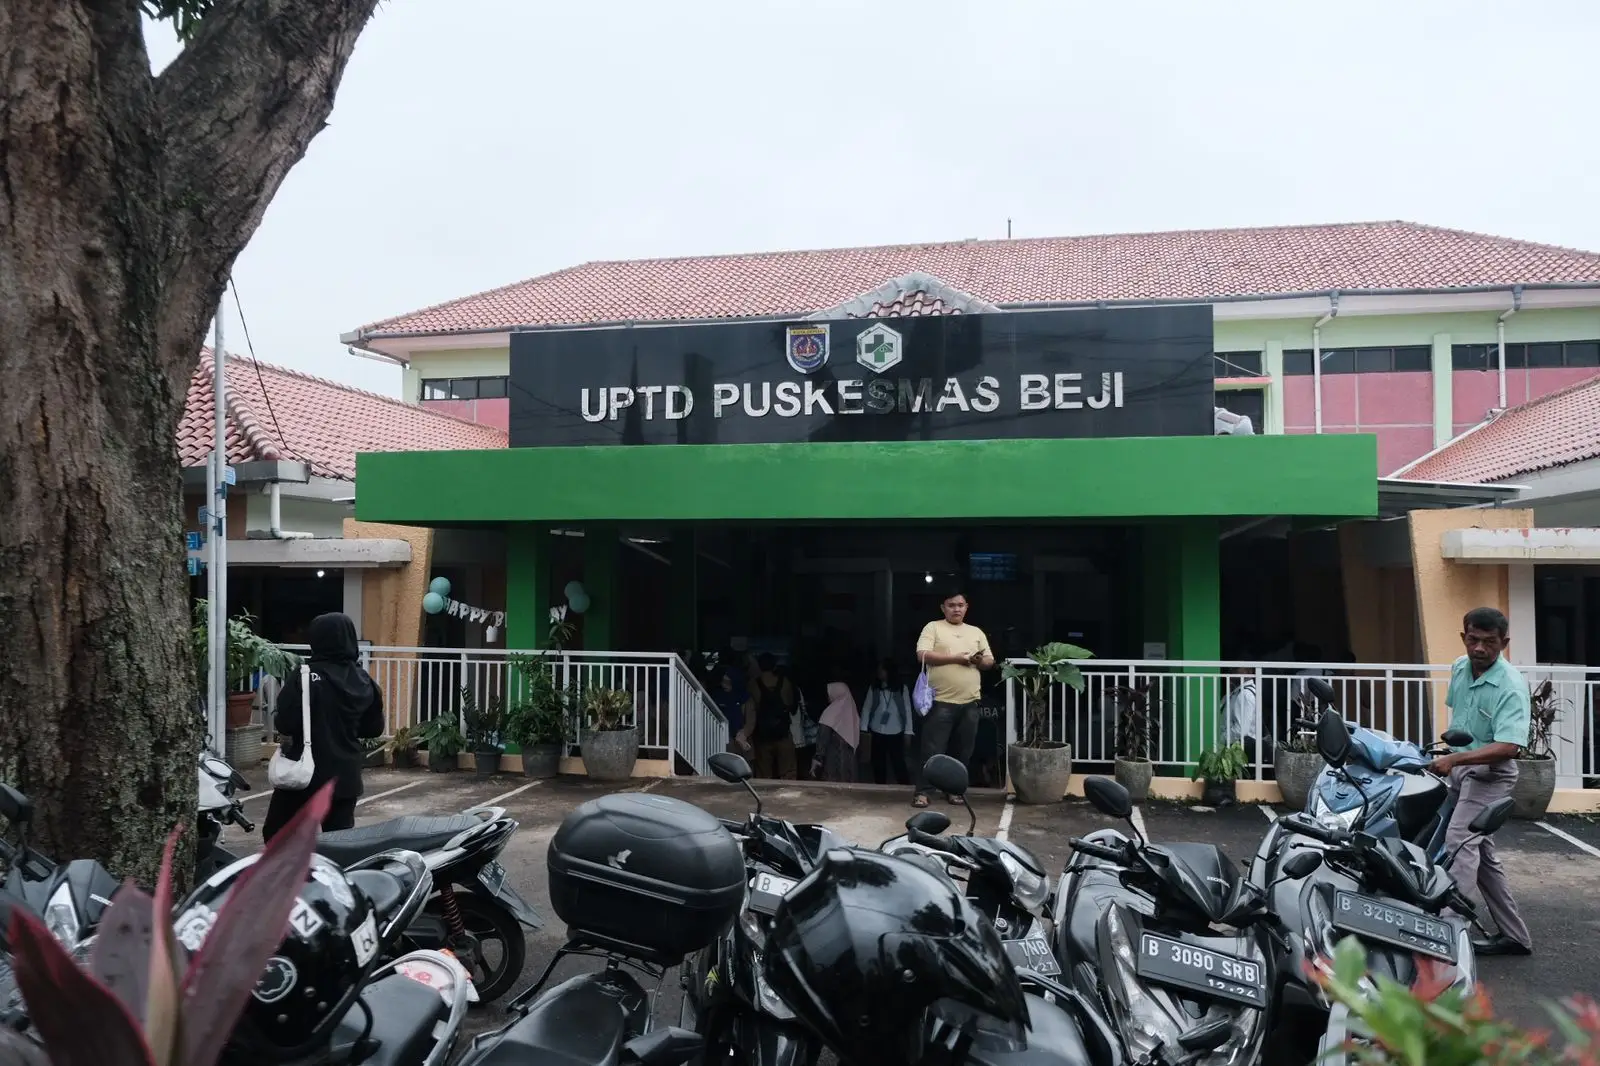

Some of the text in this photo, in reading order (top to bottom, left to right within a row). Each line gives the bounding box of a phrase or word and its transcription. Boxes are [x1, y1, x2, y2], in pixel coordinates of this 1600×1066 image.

[581, 371, 1124, 422] UPTD PUSKESMAS BEJI
[762, 877, 771, 891] B
[1341, 897, 1447, 940] B 3263 ERA
[1149, 940, 1256, 982] B 3090 SRB
